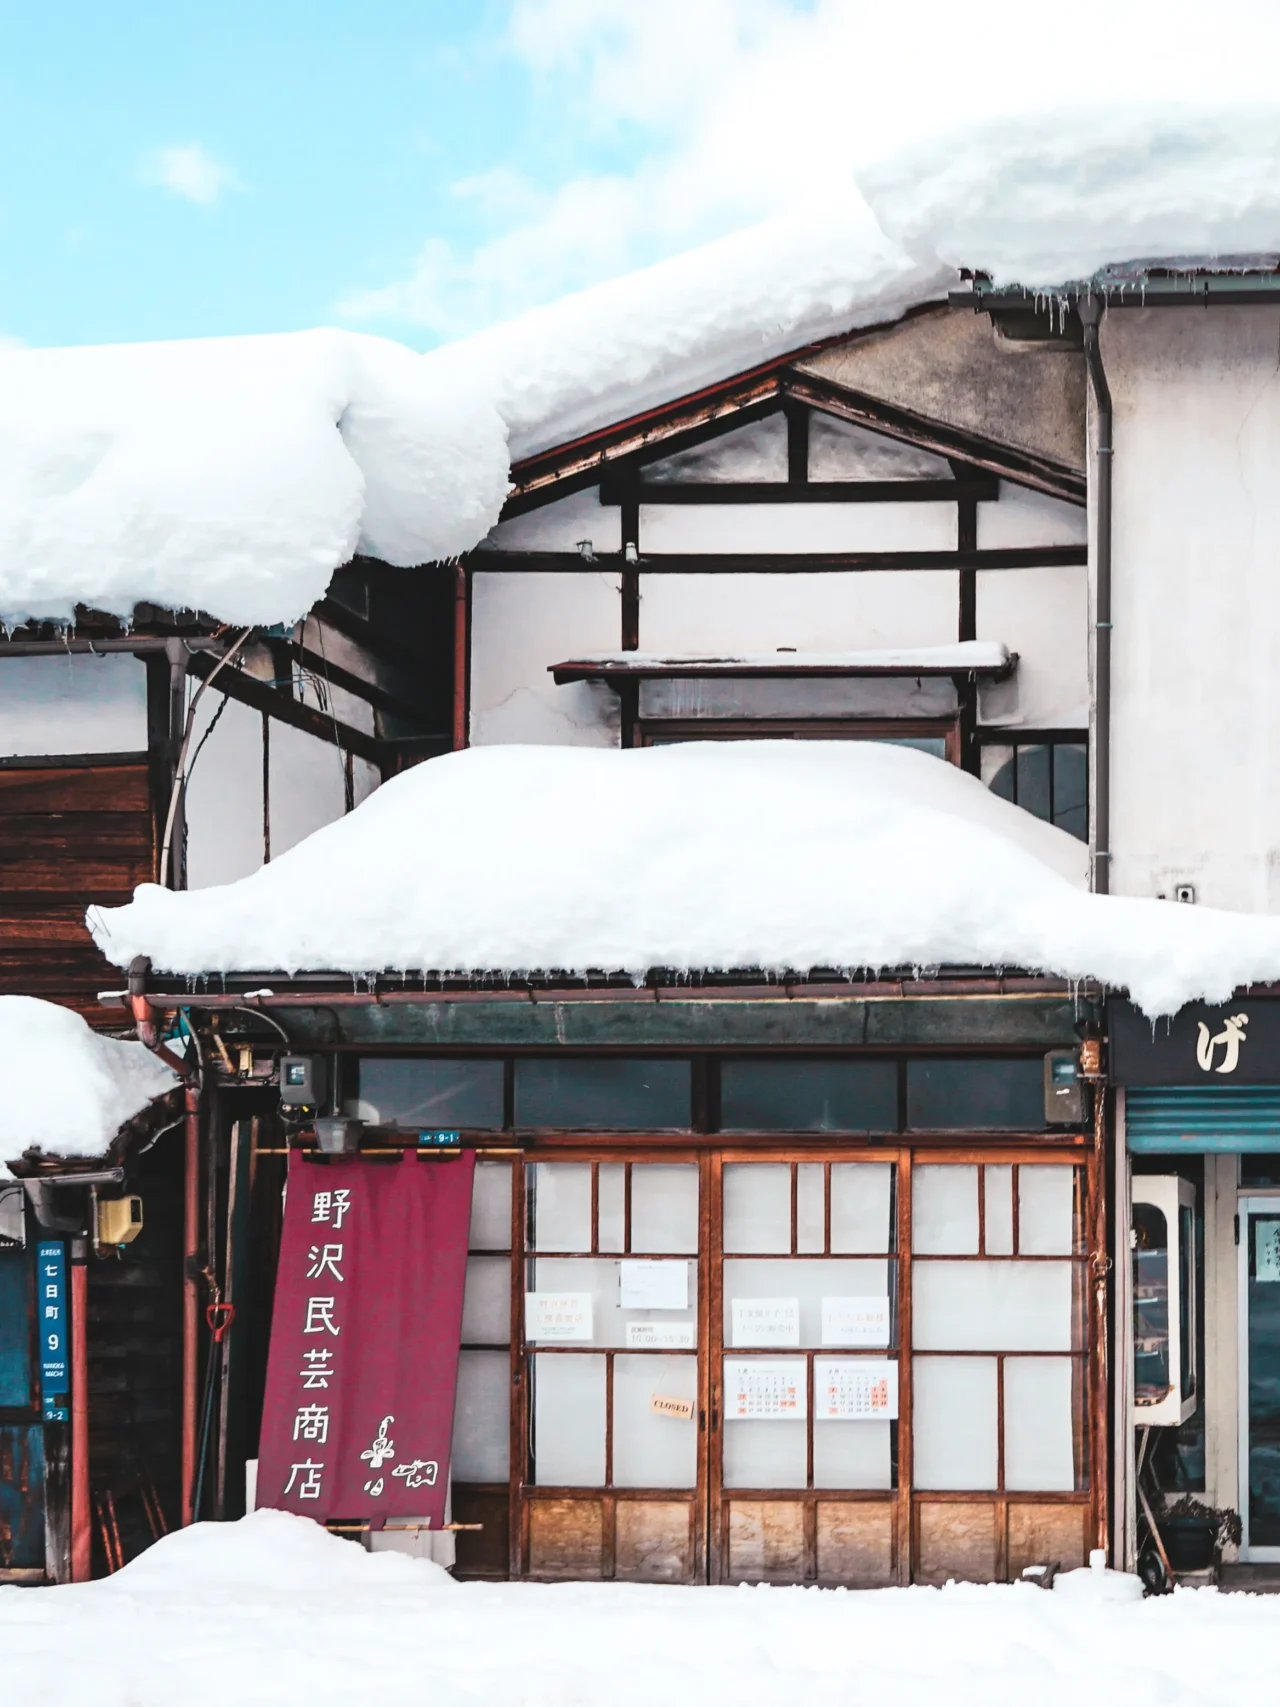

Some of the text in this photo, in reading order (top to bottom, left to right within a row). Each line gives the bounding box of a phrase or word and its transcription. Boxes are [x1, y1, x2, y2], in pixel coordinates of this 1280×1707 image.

[44, 1264, 60, 1320] 七日町
[48, 1334, 59, 1350] 9
[284, 1189, 351, 1500] 野沢民芸商店
[653, 1399, 690, 1414] CLOSED
